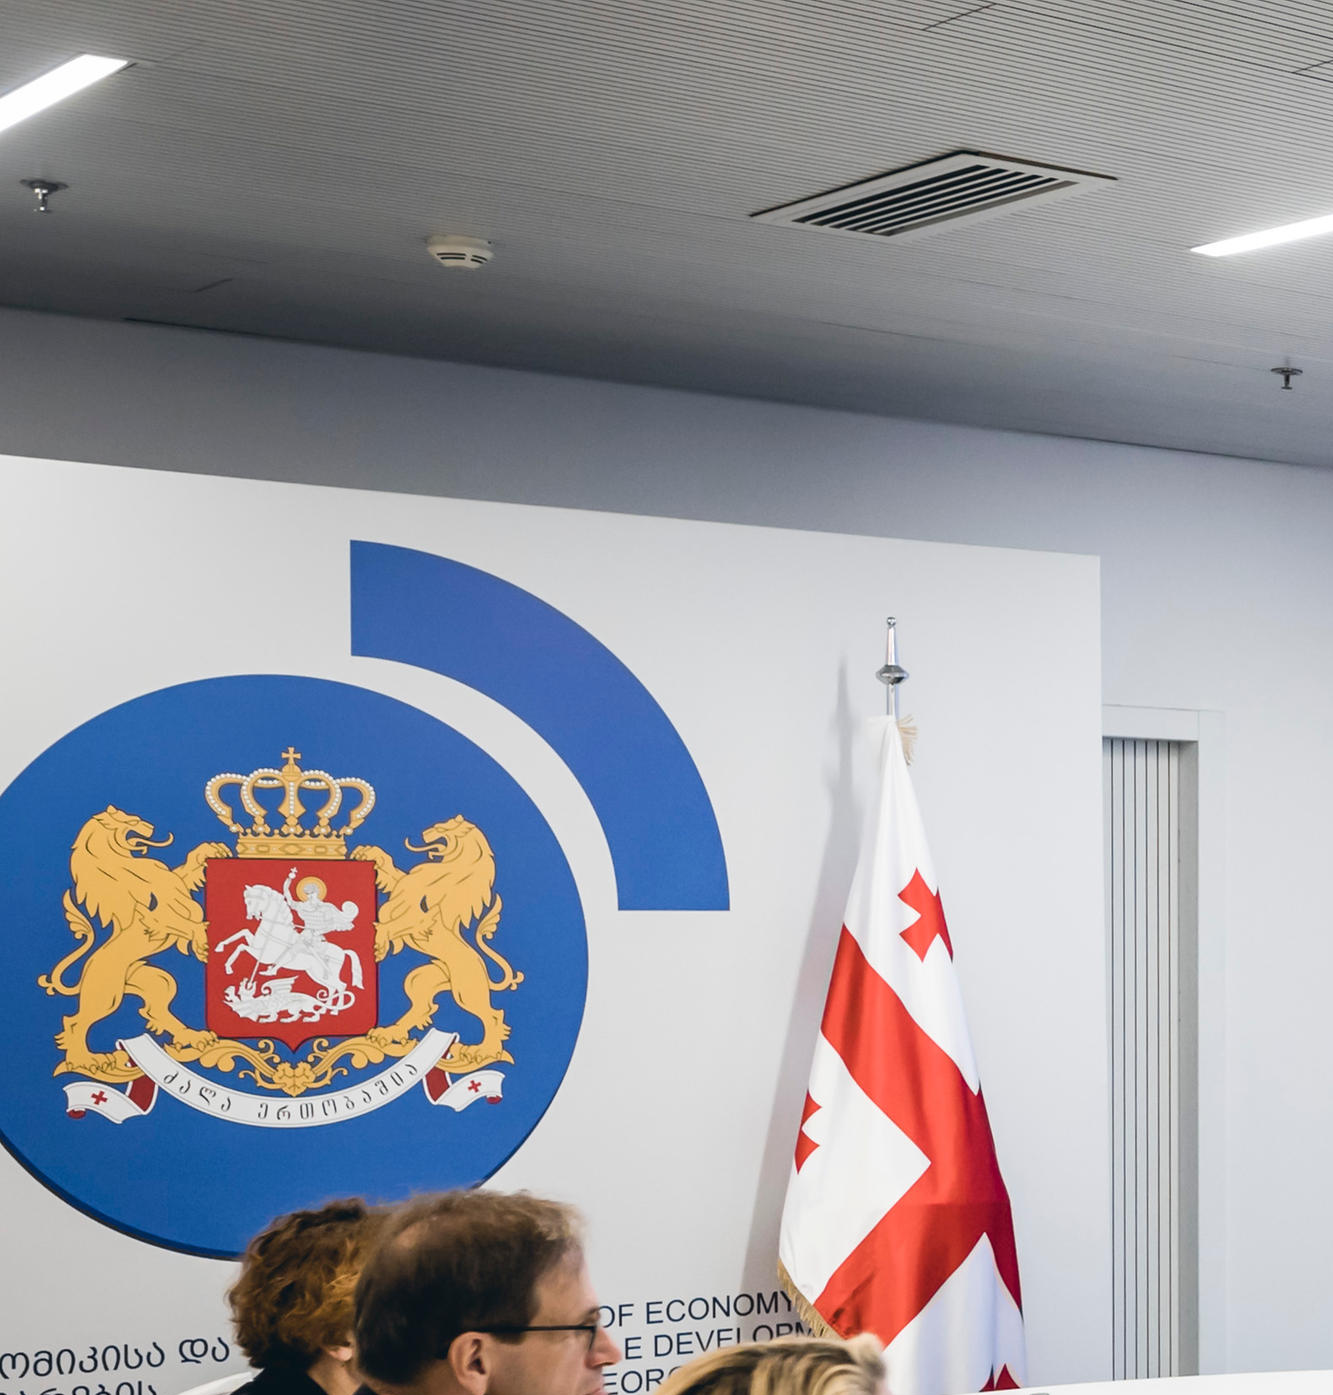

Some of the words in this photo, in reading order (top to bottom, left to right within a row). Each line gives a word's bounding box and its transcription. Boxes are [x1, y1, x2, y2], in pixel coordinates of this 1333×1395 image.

[162, 1070, 233, 1113] ძალა
[257, 1062, 420, 1121] ერთობაშია
[178, 1336, 230, 1365] და
